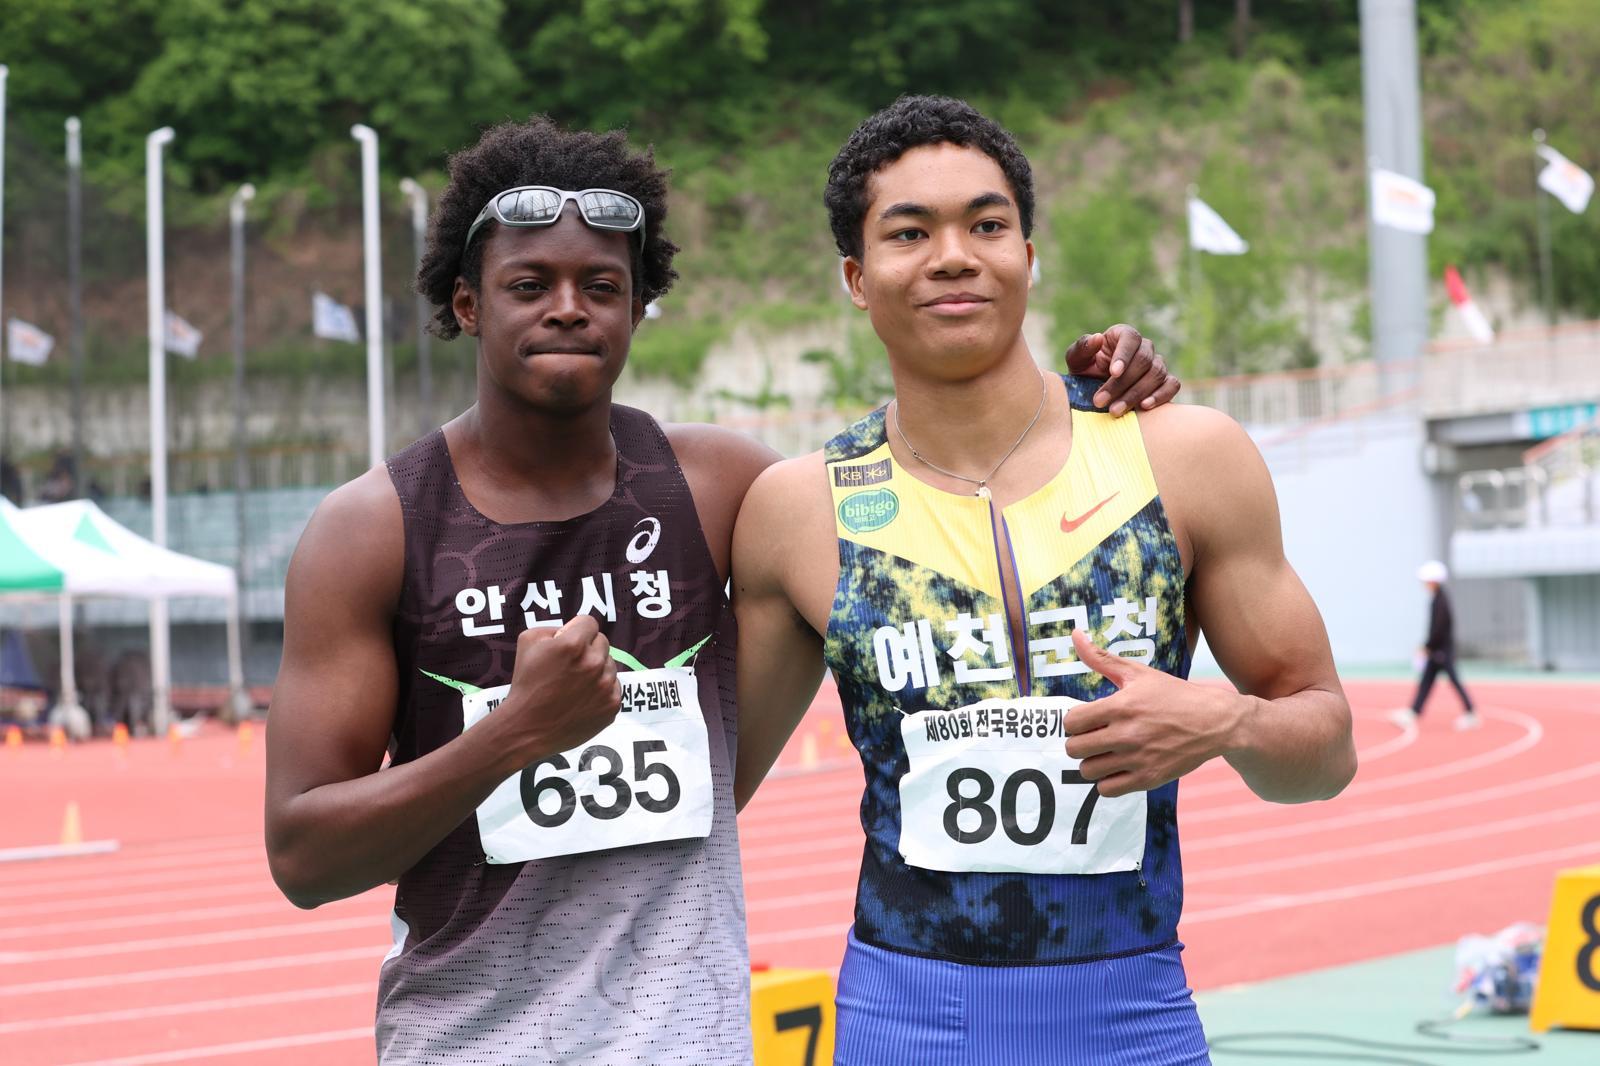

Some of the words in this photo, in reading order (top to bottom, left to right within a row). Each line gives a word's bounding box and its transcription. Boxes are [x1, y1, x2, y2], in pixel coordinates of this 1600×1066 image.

[845, 500, 895, 518] bibigo
[455, 570, 673, 637] 안산시청
[873, 596, 1158, 692] 예천군청
[621, 680, 682, 712] 선수권대회
[924, 710, 973, 742] 제80회
[976, 708, 1072, 738] 전국육상경기
[519, 740, 681, 828] 635
[943, 767, 1101, 846] 807
